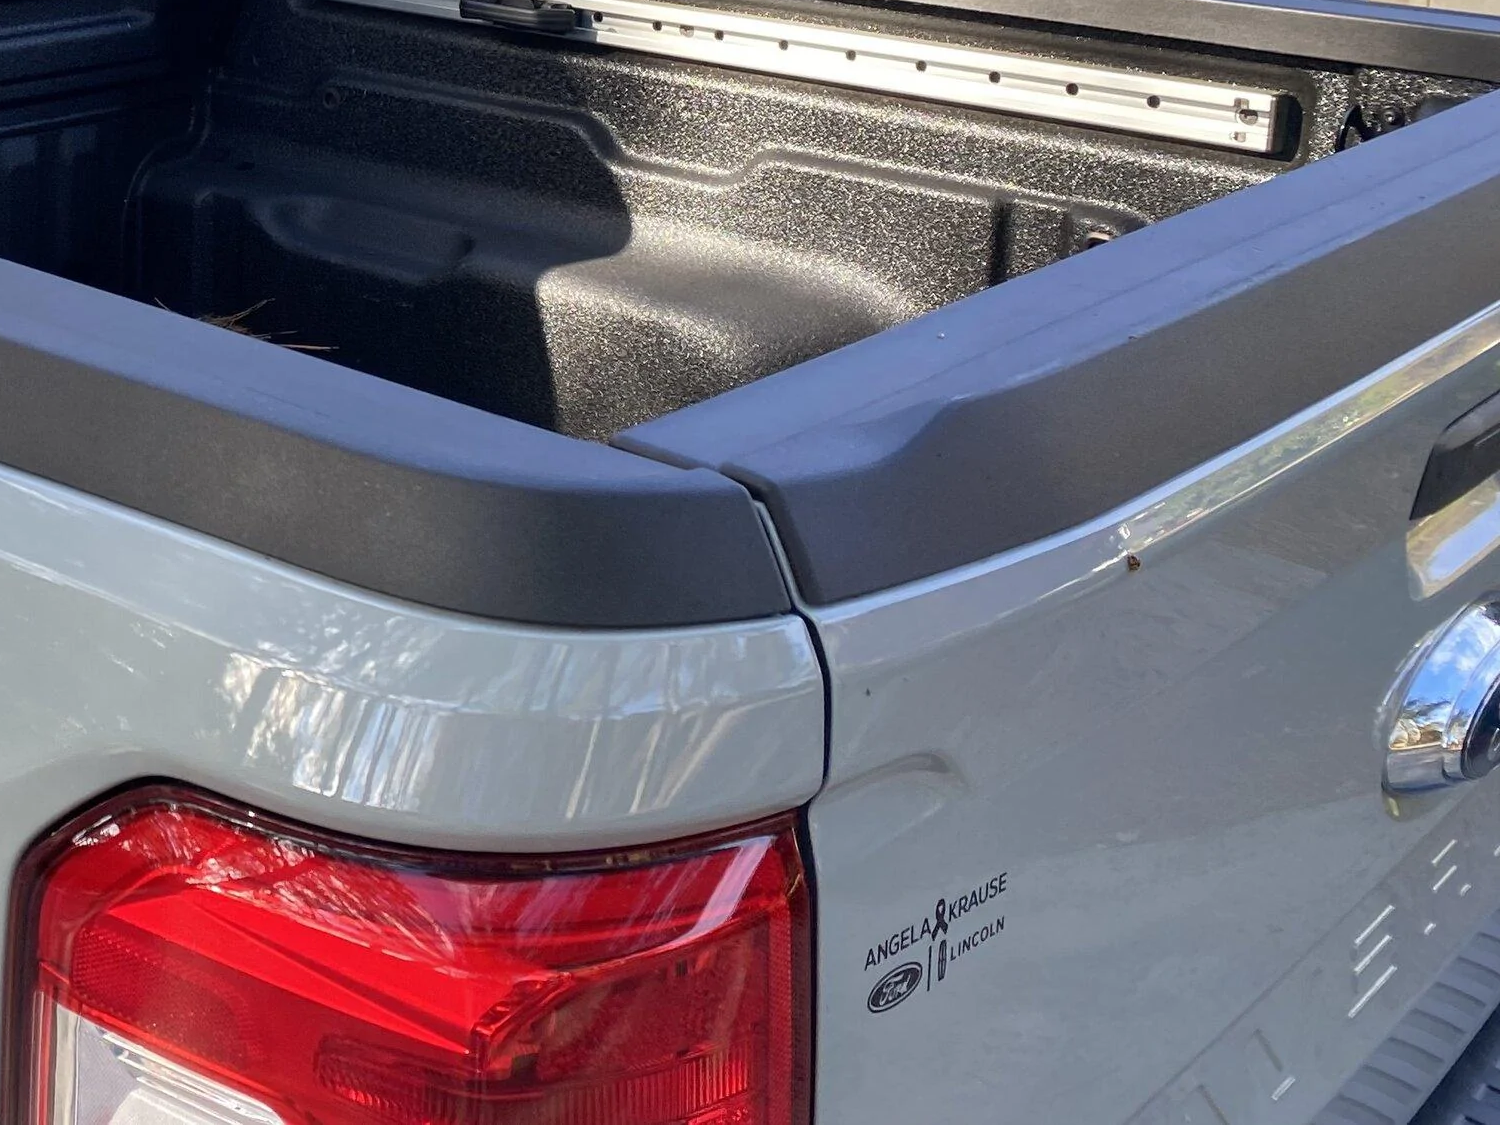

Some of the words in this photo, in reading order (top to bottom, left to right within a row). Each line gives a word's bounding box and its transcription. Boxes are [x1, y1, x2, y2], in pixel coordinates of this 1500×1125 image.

[864, 917, 932, 971] ANGELA
[949, 872, 1008, 923] KRAUSE
[950, 915, 1006, 962] LINCOLN
